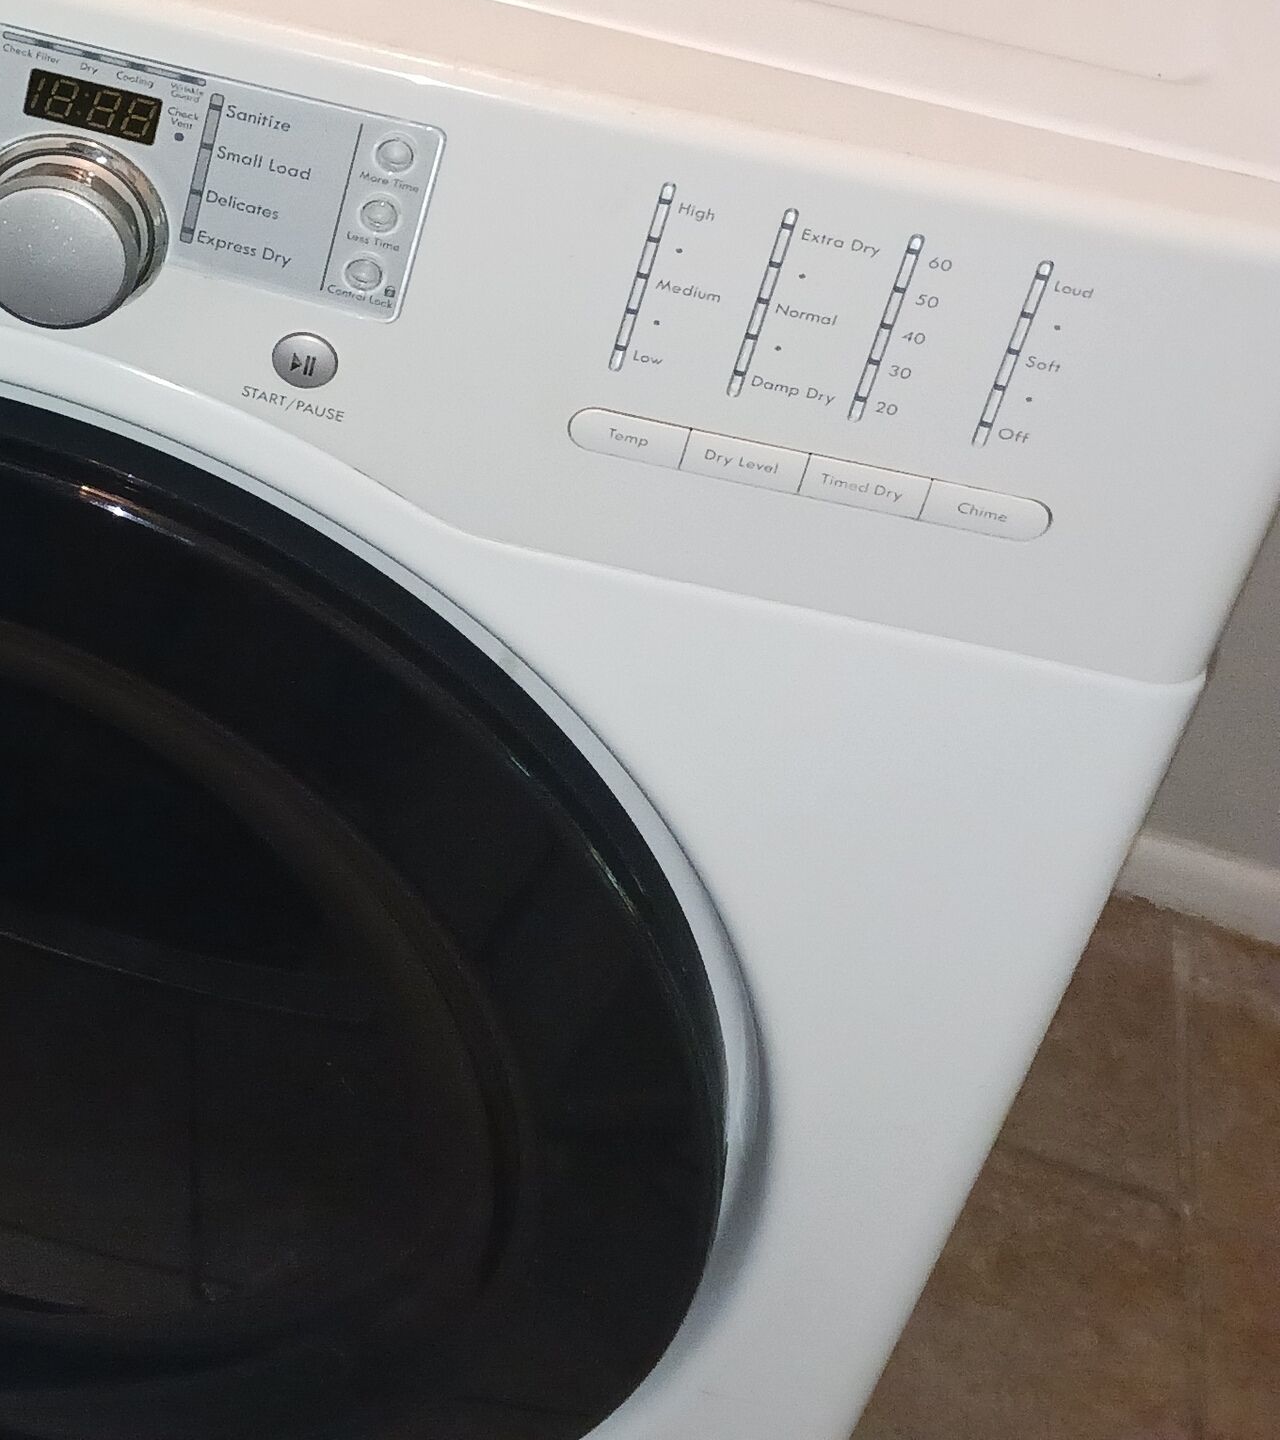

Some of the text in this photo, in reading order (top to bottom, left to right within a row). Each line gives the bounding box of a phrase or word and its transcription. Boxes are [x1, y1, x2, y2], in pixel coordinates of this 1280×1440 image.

[2, 43, 60, 65] Check Filter
[80, 62, 99, 76] Dry
[116, 70, 155, 89] Cooling
[167, 106, 200, 121] Check
[225, 104, 292, 132] Sanitize
[216, 145, 313, 181] Small Load
[359, 170, 420, 193] More Time
[205, 189, 280, 221] Delicates
[678, 202, 716, 223] High
[196, 230, 293, 269] Express Dry
[346, 230, 401, 253] Less Time
[800, 228, 882, 259] Extra Dry
[928, 257, 953, 273] 60
[327, 284, 394, 310] Control Lock
[655, 278, 722, 305] Medium
[916, 294, 940, 310] 50
[1054, 280, 1095, 301] Loud
[775, 303, 839, 328] Normal
[902, 330, 926, 347] 40
[632, 349, 664, 367] Low
[1025, 355, 1062, 375] Soft
[889, 365, 913, 381] 30
[751, 375, 837, 407] Damp Dry
[240, 384, 346, 423] START/PAUSE
[875, 401, 899, 417] 20
[608, 427, 650, 450] Temp
[998, 426, 1031, 445] Off
[704, 448, 780, 475] Dry Level
[821, 472, 904, 504] Timed Dry
[956, 501, 1009, 525] Chime
